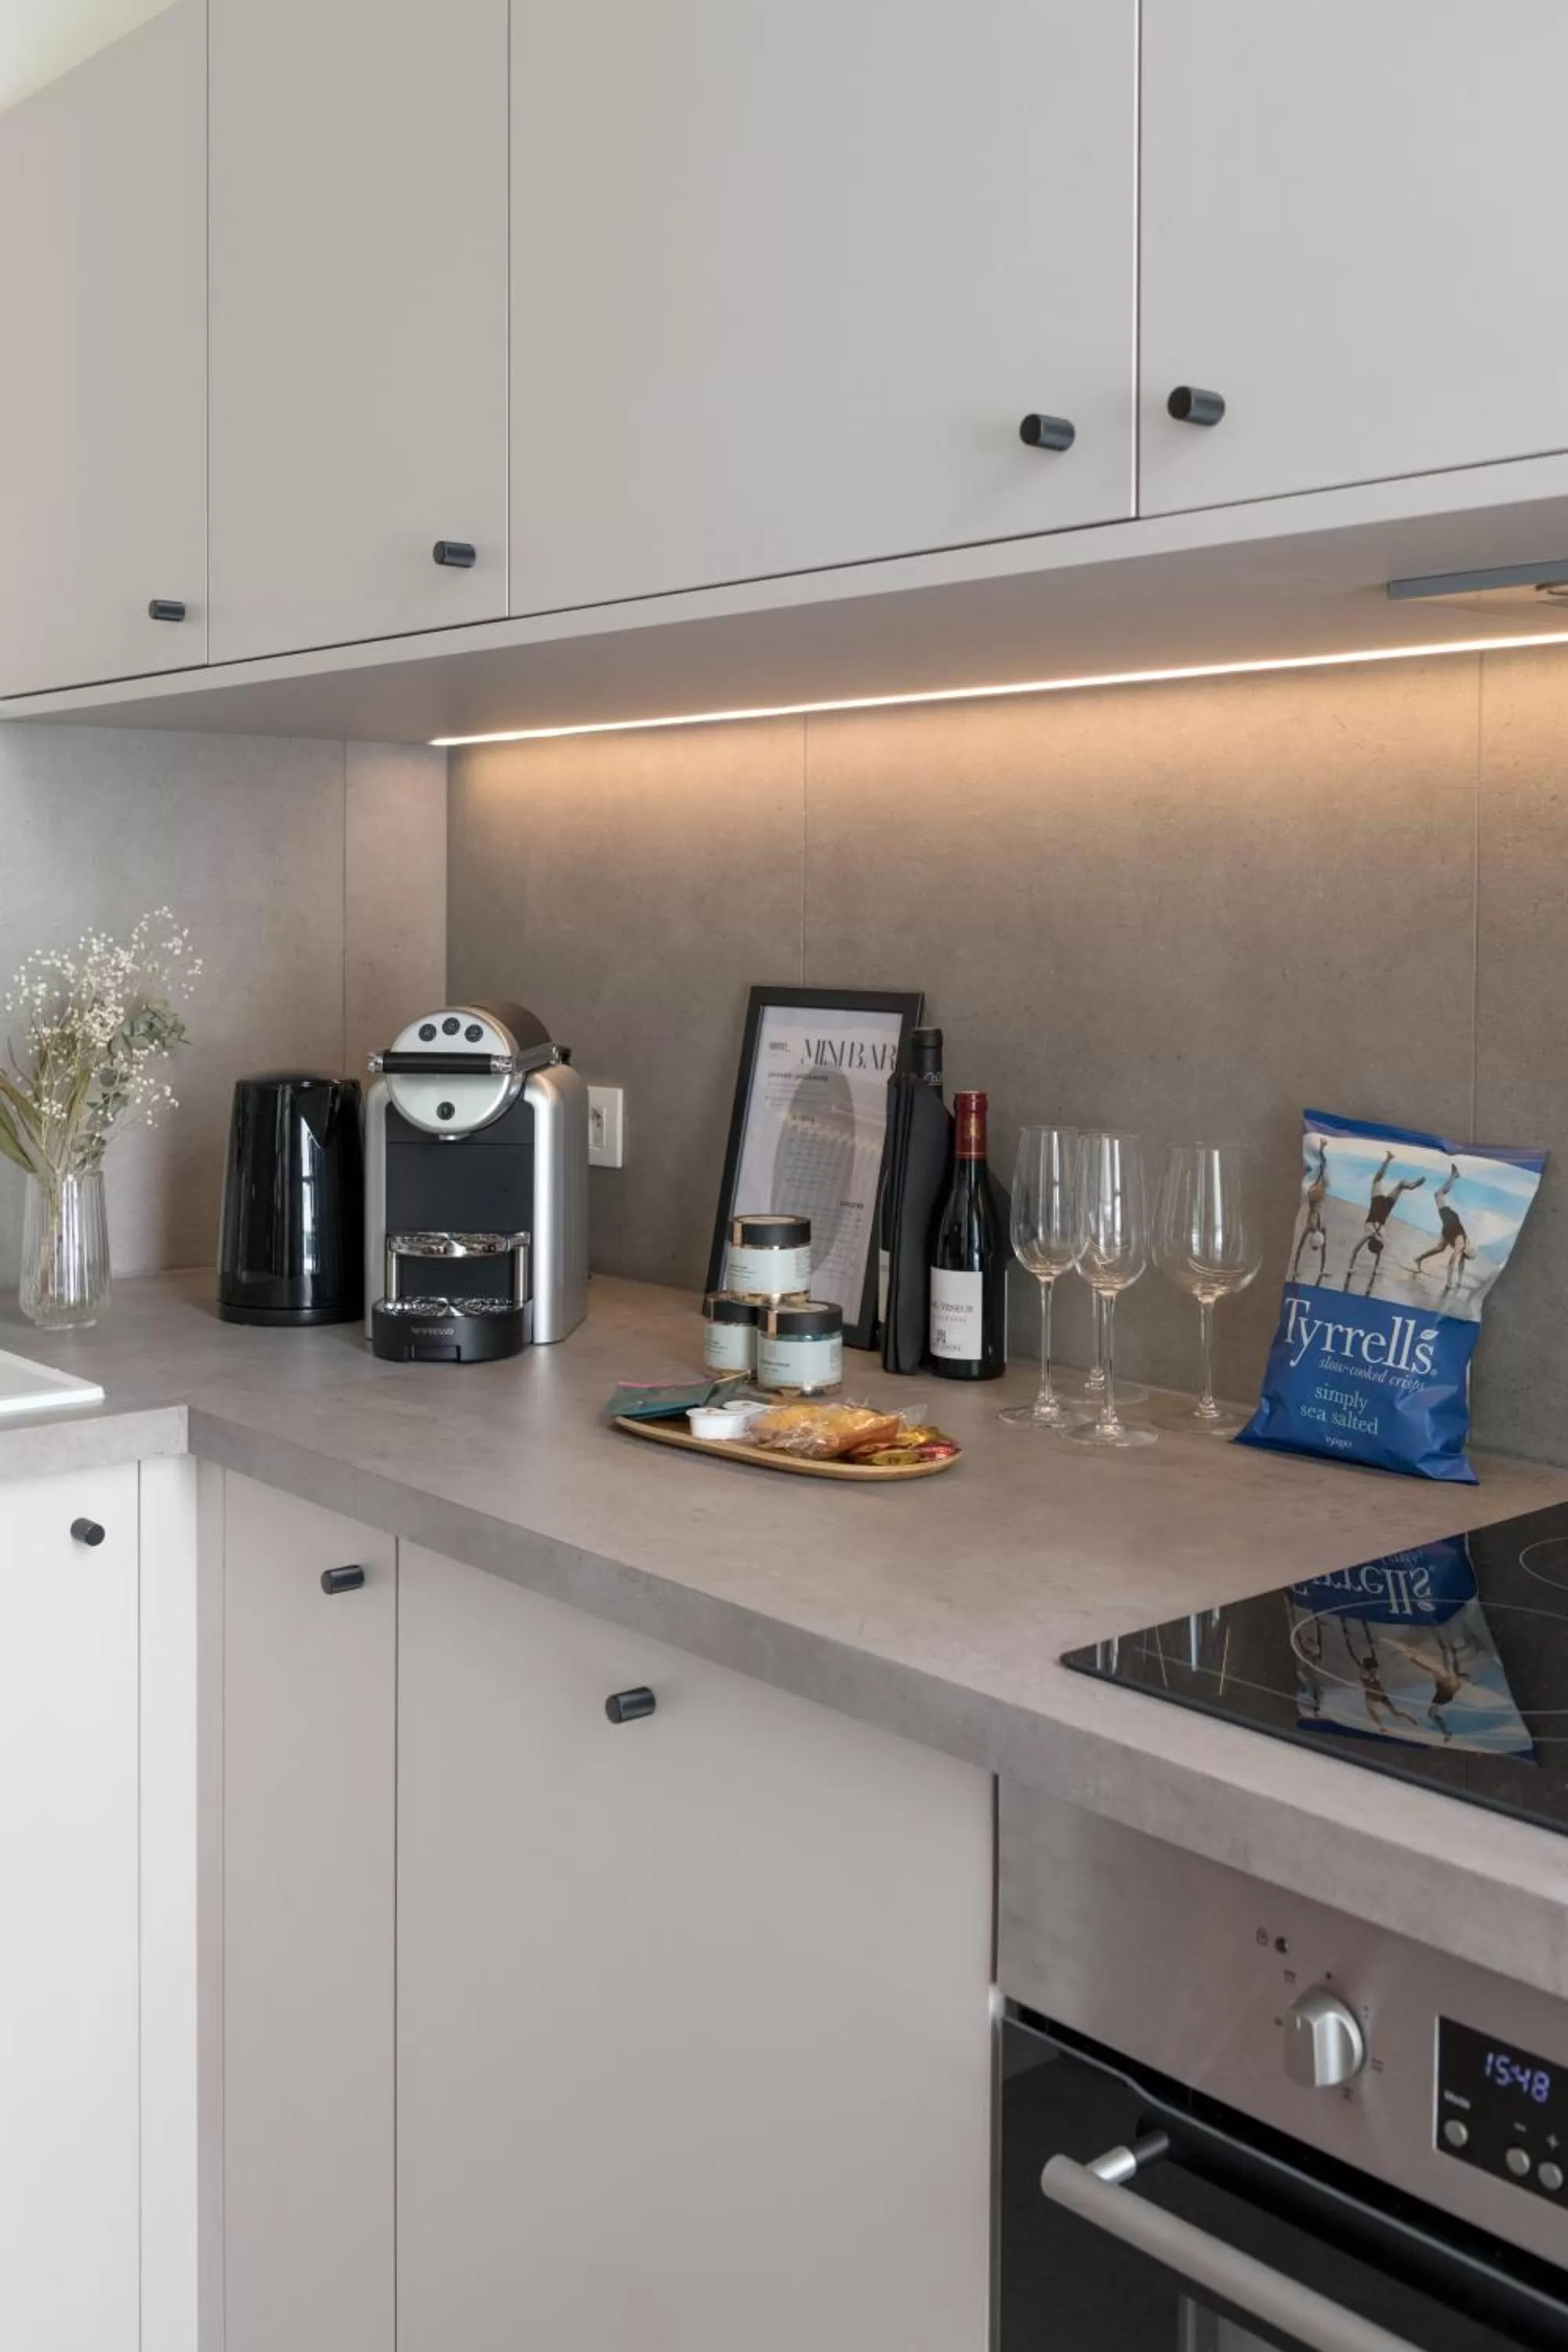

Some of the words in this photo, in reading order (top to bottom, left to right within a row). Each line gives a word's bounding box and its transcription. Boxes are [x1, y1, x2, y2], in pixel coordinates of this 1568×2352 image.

[1314, 1382, 1368, 1414] simply
[1298, 1403, 1327, 1422] sea
[1331, 1410, 1378, 1436] salted
